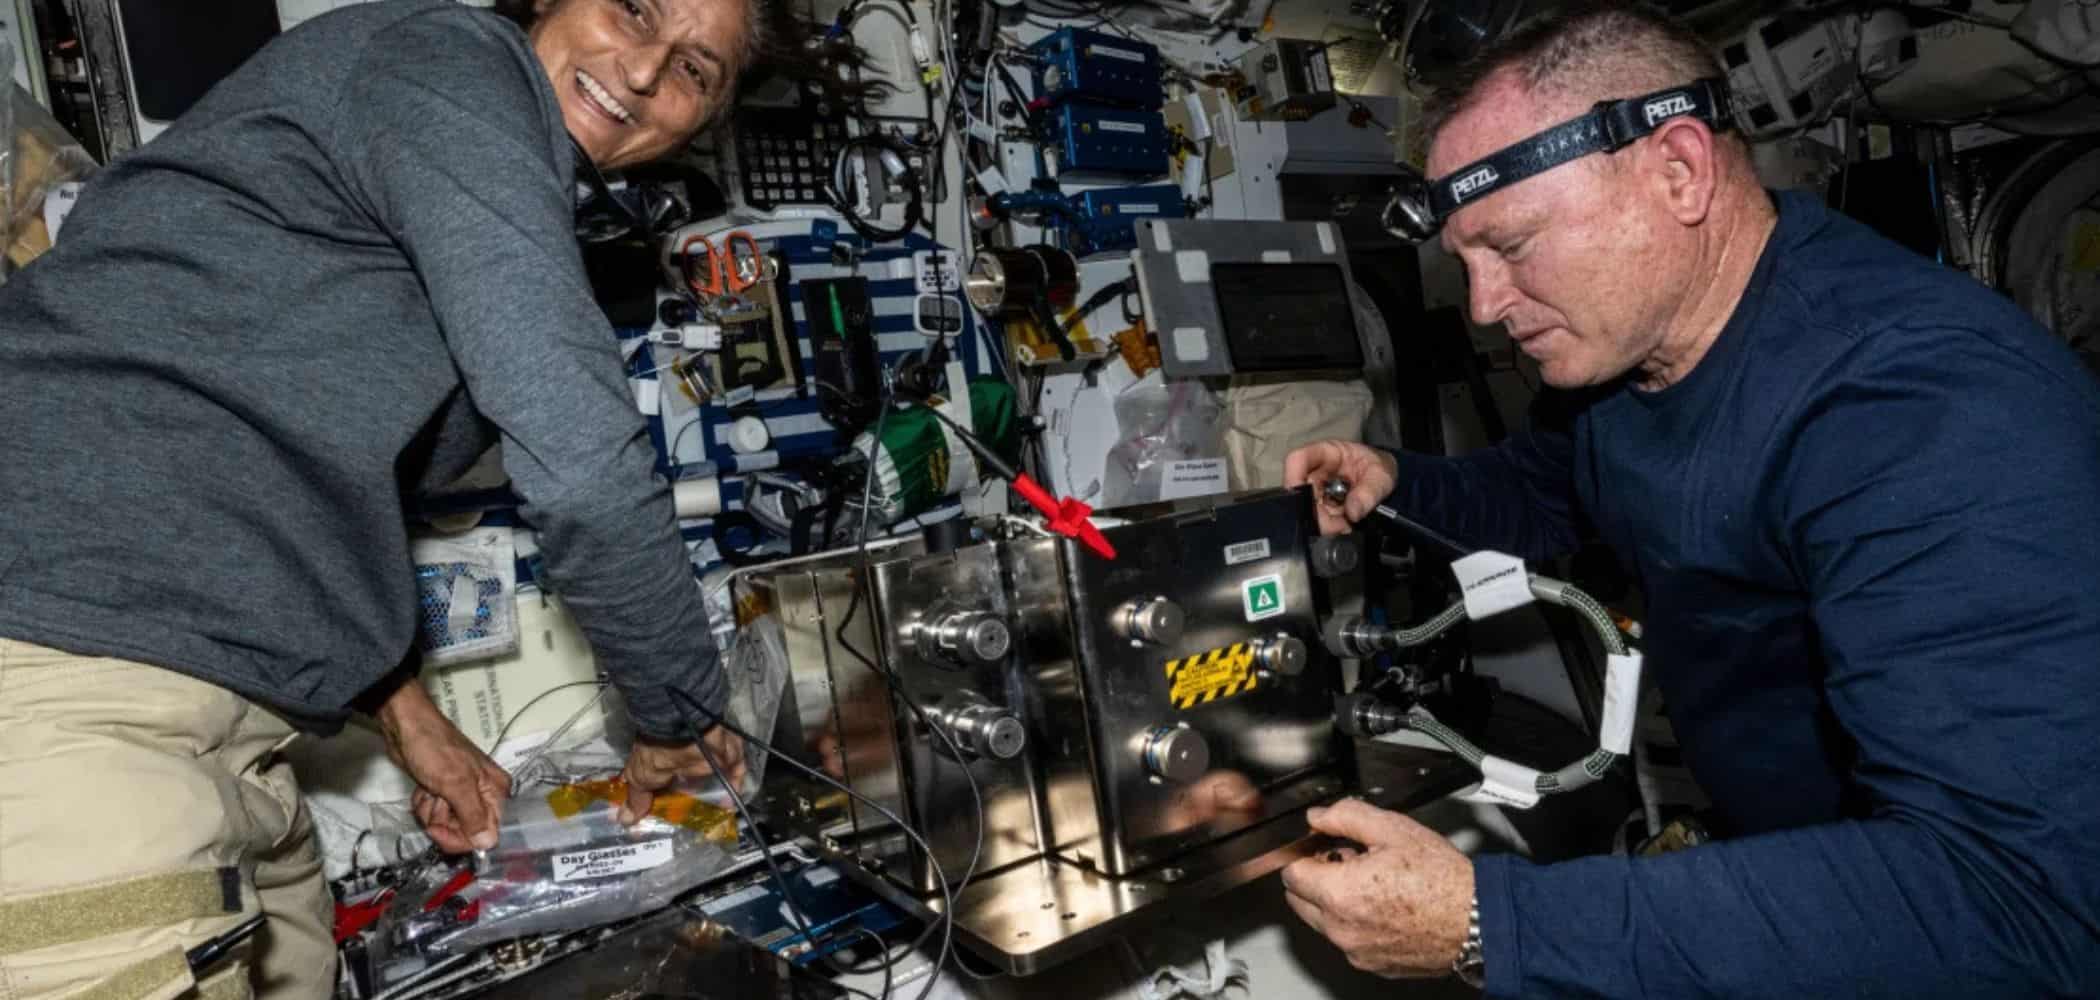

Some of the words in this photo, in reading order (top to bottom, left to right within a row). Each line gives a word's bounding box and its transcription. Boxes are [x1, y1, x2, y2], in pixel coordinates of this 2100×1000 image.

[1645, 95, 1697, 127] PETZL
[1536, 126, 1599, 158] TIKKA
[1451, 167, 1499, 203] PETZL
[561, 854, 586, 866] Day
[587, 847, 637, 861] Glasses
